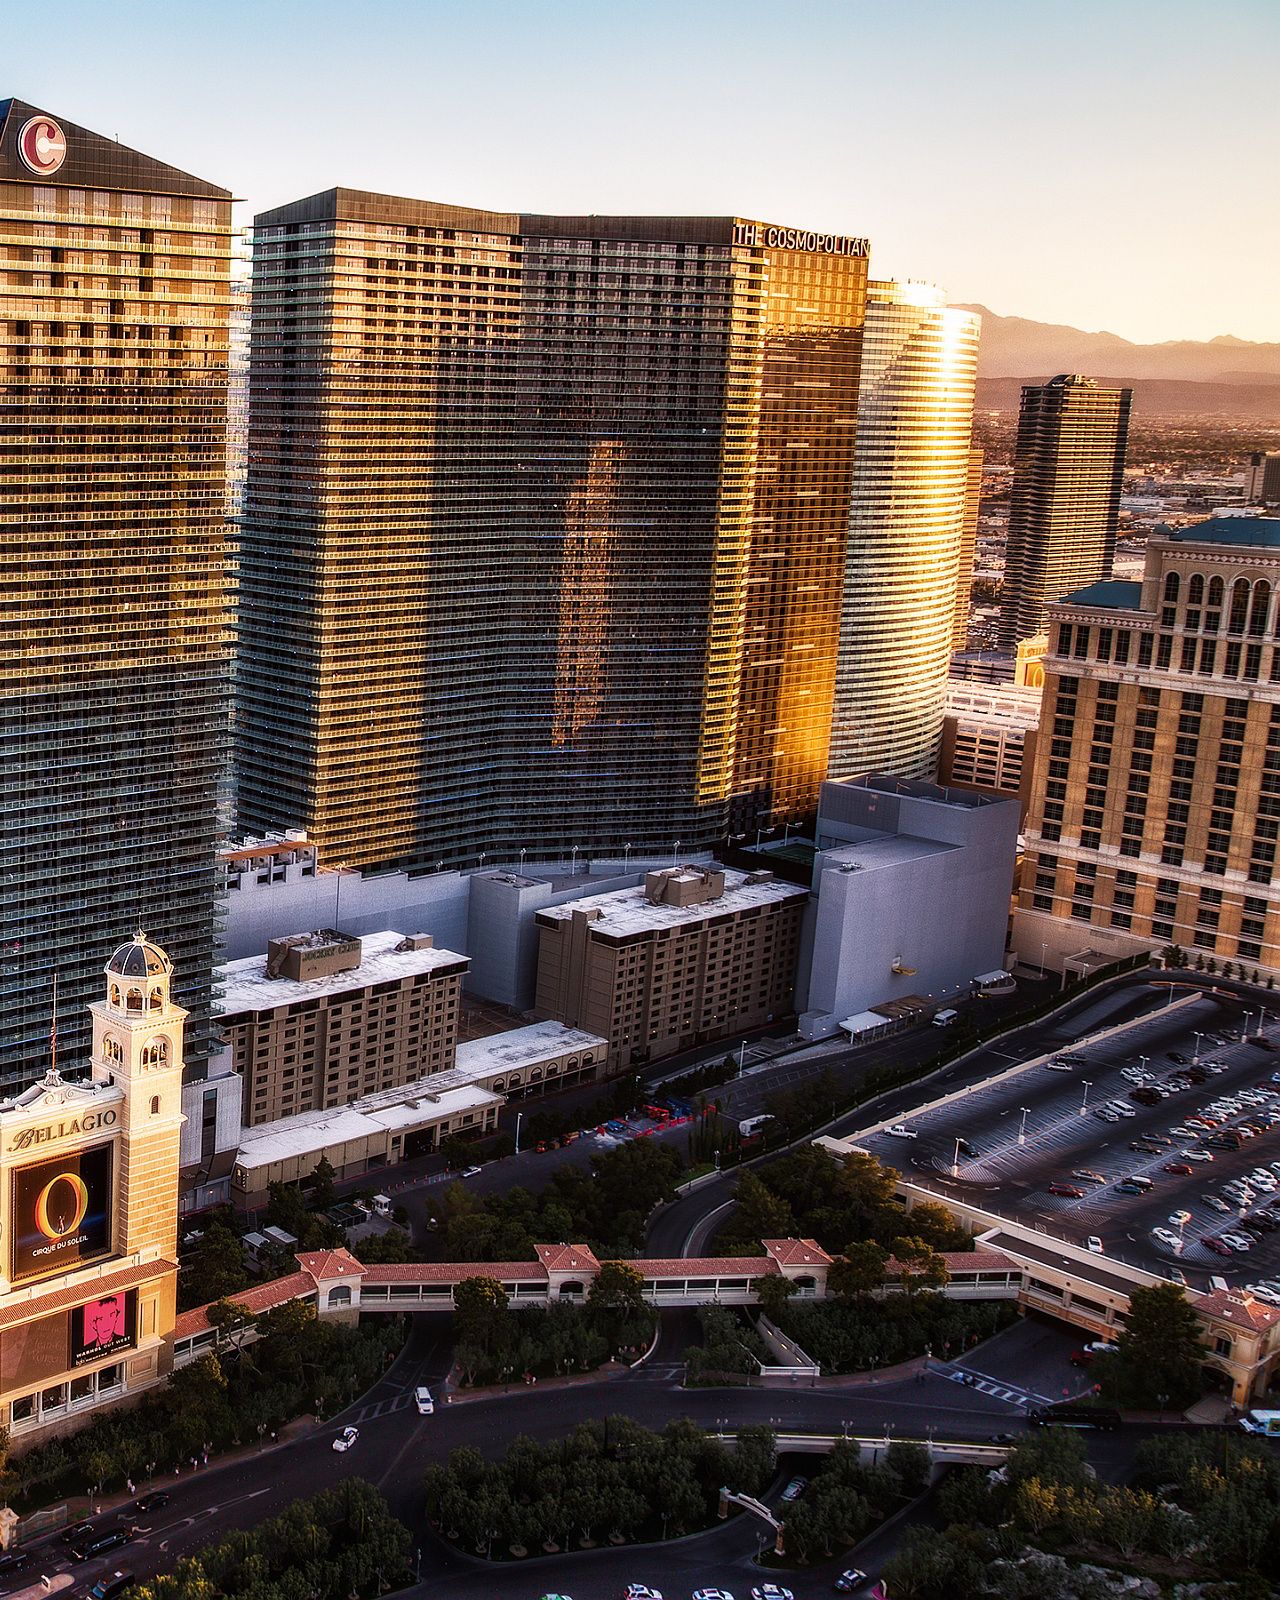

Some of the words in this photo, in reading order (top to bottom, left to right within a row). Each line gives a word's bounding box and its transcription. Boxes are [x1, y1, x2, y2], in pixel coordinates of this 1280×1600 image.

[734, 223, 765, 247] THE
[768, 226, 870, 257] COSMOPOLITAN
[338, 942, 361, 955] CLUB
[6, 1109, 117, 1152] BELLAGIO
[35, 1172, 89, 1240] O
[32, 1244, 57, 1258] CIRQUE
[57, 1240, 67, 1250] DU
[67, 1235, 89, 1247] SOLEIL
[103, 1341, 115, 1349] OUT
[115, 1335, 131, 1345] WEST
